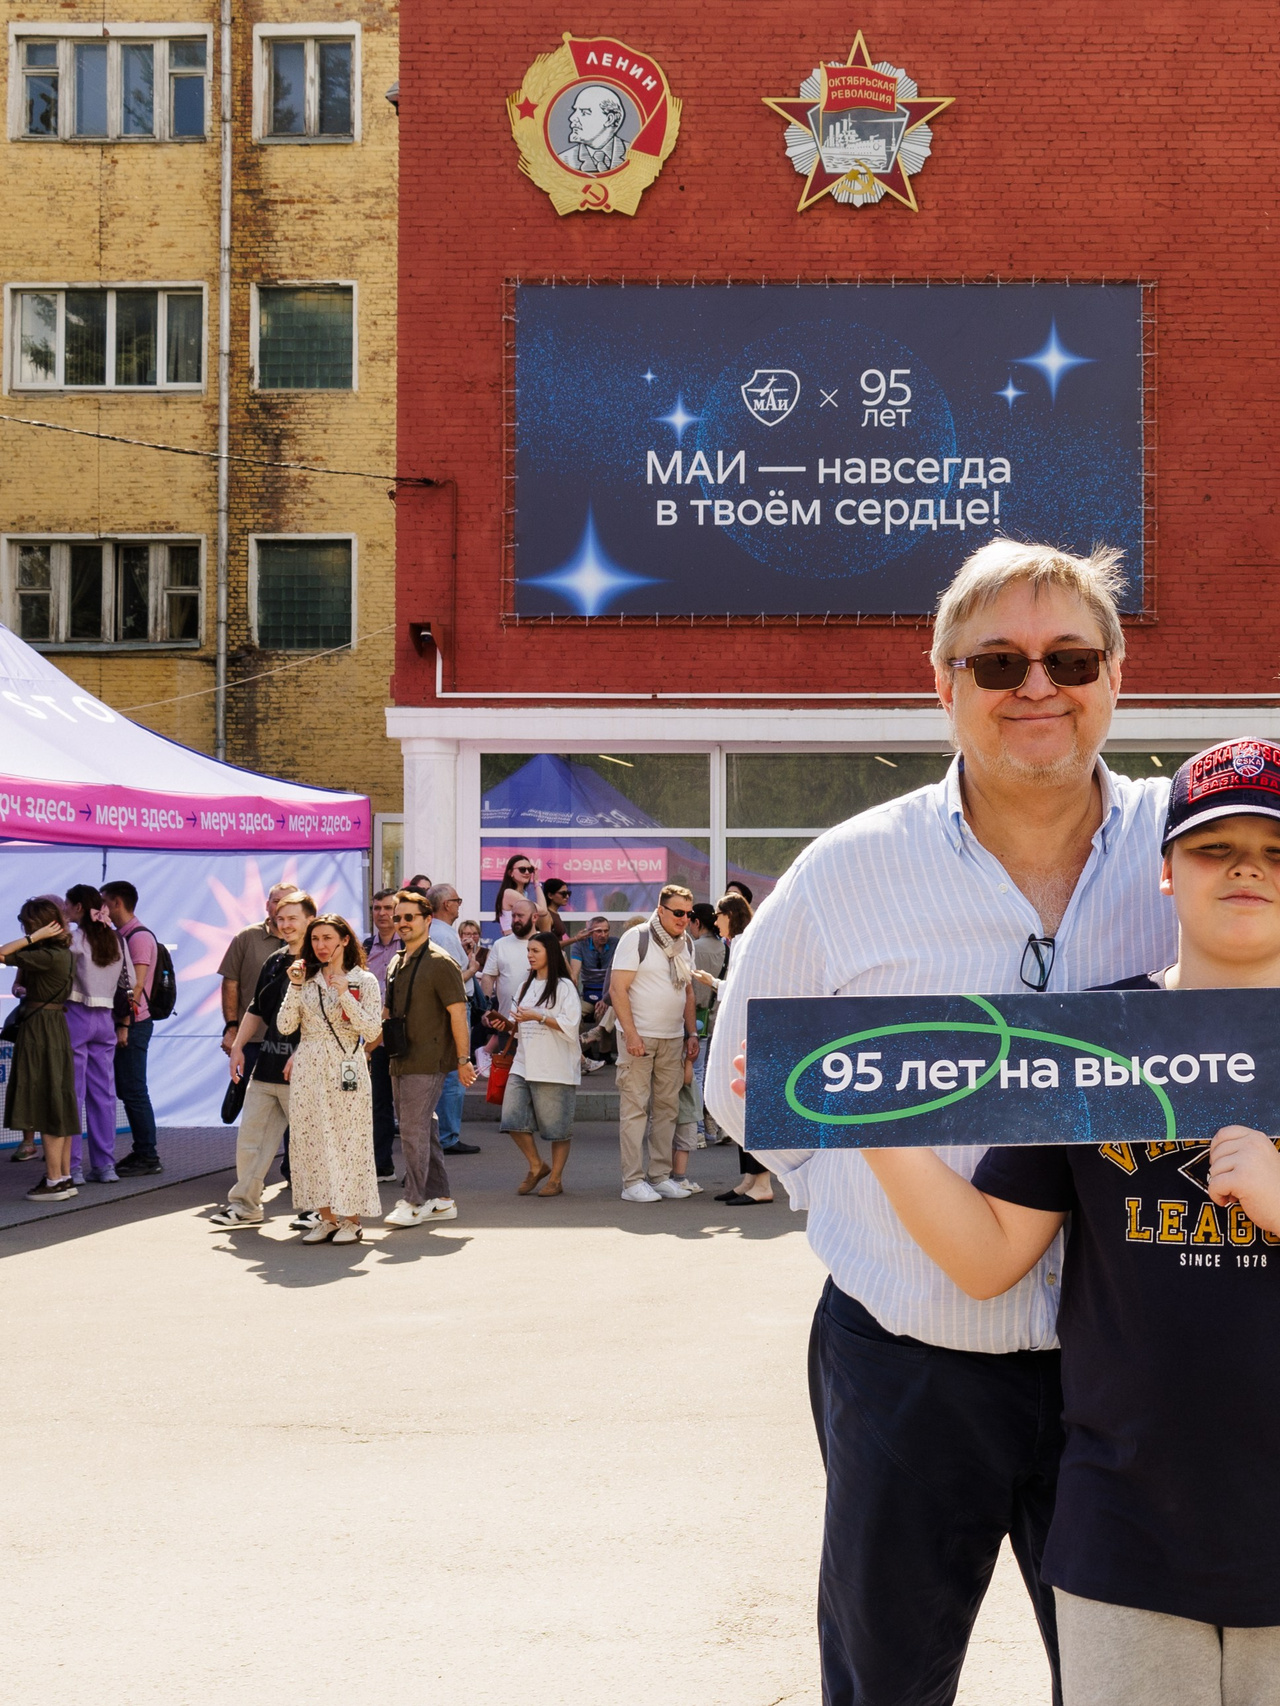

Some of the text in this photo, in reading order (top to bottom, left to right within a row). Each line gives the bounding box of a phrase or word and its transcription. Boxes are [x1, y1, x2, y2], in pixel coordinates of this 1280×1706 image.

[586, 52, 657, 91] ЛЕНИН
[828, 76, 895, 92] ОКТЯБРЬСКАЯ
[831, 89, 892, 104] РЕВОЛЮЦИЯ
[753, 389, 789, 412] МАИ
[860, 368, 912, 407] 95
[861, 408, 912, 427] лет
[646, 450, 746, 485] МАИ
[818, 456, 1011, 489] навсегда
[656, 490, 1001, 534] в твоём сердце!
[1195, 745, 1234, 778] CSKA
[1236, 757, 1262, 766] CSKA
[25, 796, 76, 823] здесь
[96, 804, 138, 833] мерч
[141, 807, 184, 832] здесь
[200, 811, 237, 837] мерч
[239, 812, 275, 835] здесь
[288, 814, 319, 838] мерч
[320, 815, 352, 836] здесь
[821, 1051, 1256, 1093] 95 лет на высоте
[1179, 1252, 1268, 1268] SINCE 1978
